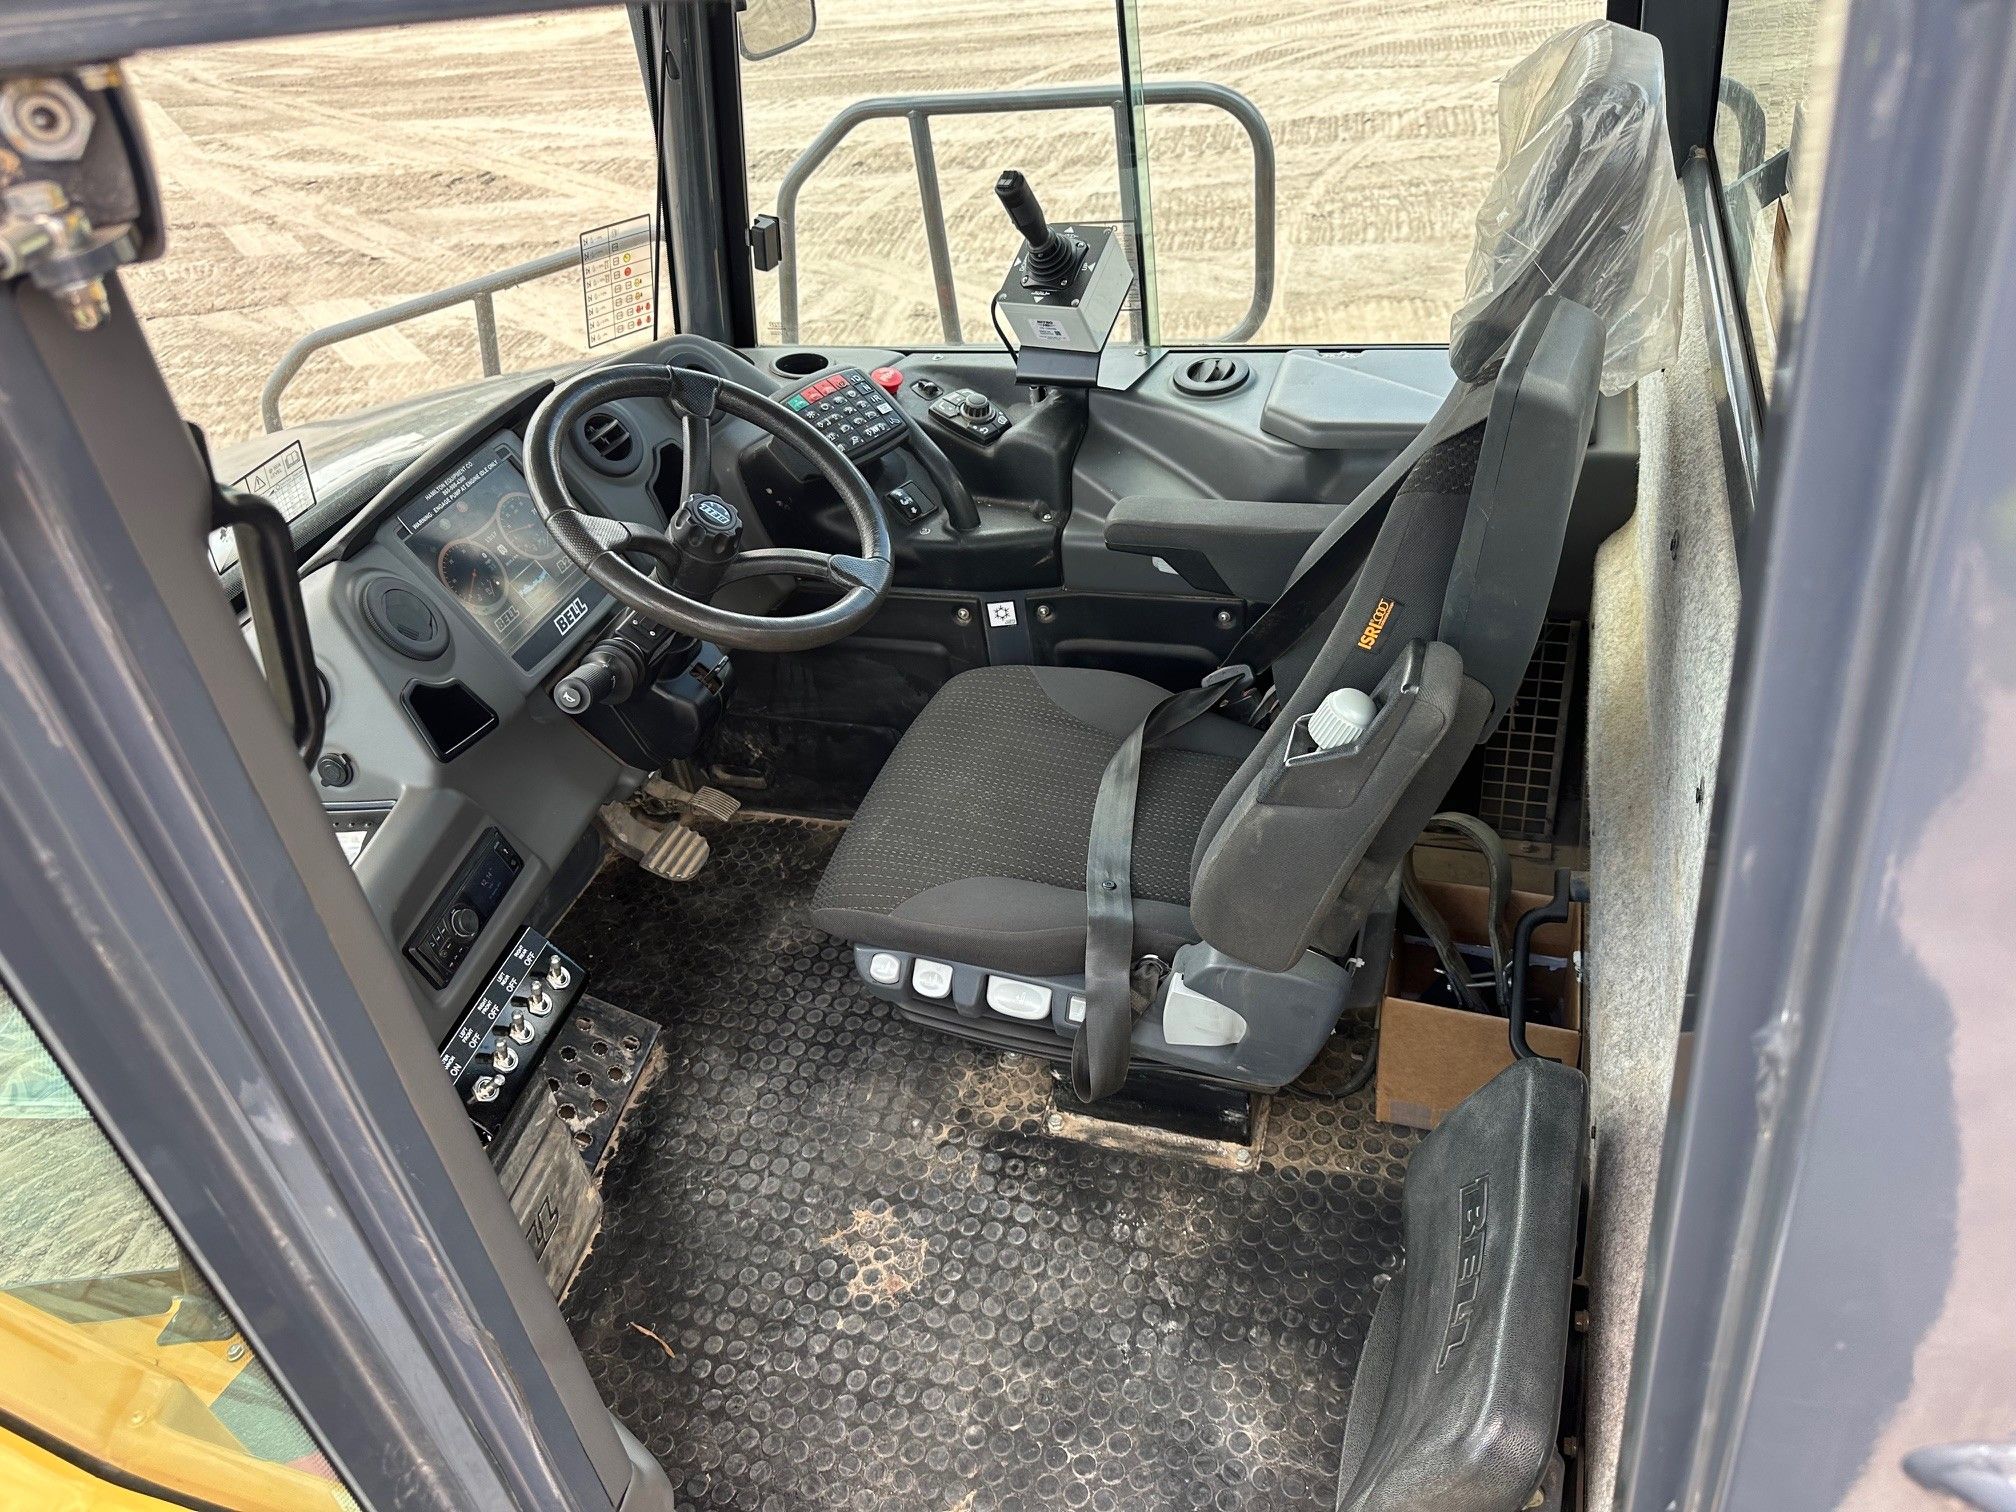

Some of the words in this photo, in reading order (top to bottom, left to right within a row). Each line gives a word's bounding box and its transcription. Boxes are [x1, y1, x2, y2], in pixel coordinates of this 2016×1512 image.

[424, 483, 446, 501] HAMILTON
[445, 466, 466, 486] EQUIPMENT
[432, 497, 451, 513] ENGAGE
[494, 606, 520, 632] BELL
[554, 598, 588, 636] BELL
[524, 952, 536, 966] OFF
[506, 977, 518, 992] OFF
[488, 1004, 500, 1020] OFF
[468, 1034, 481, 1049] OFF
[450, 1063, 462, 1076] ON
[1436, 1172, 1490, 1374] BELL
